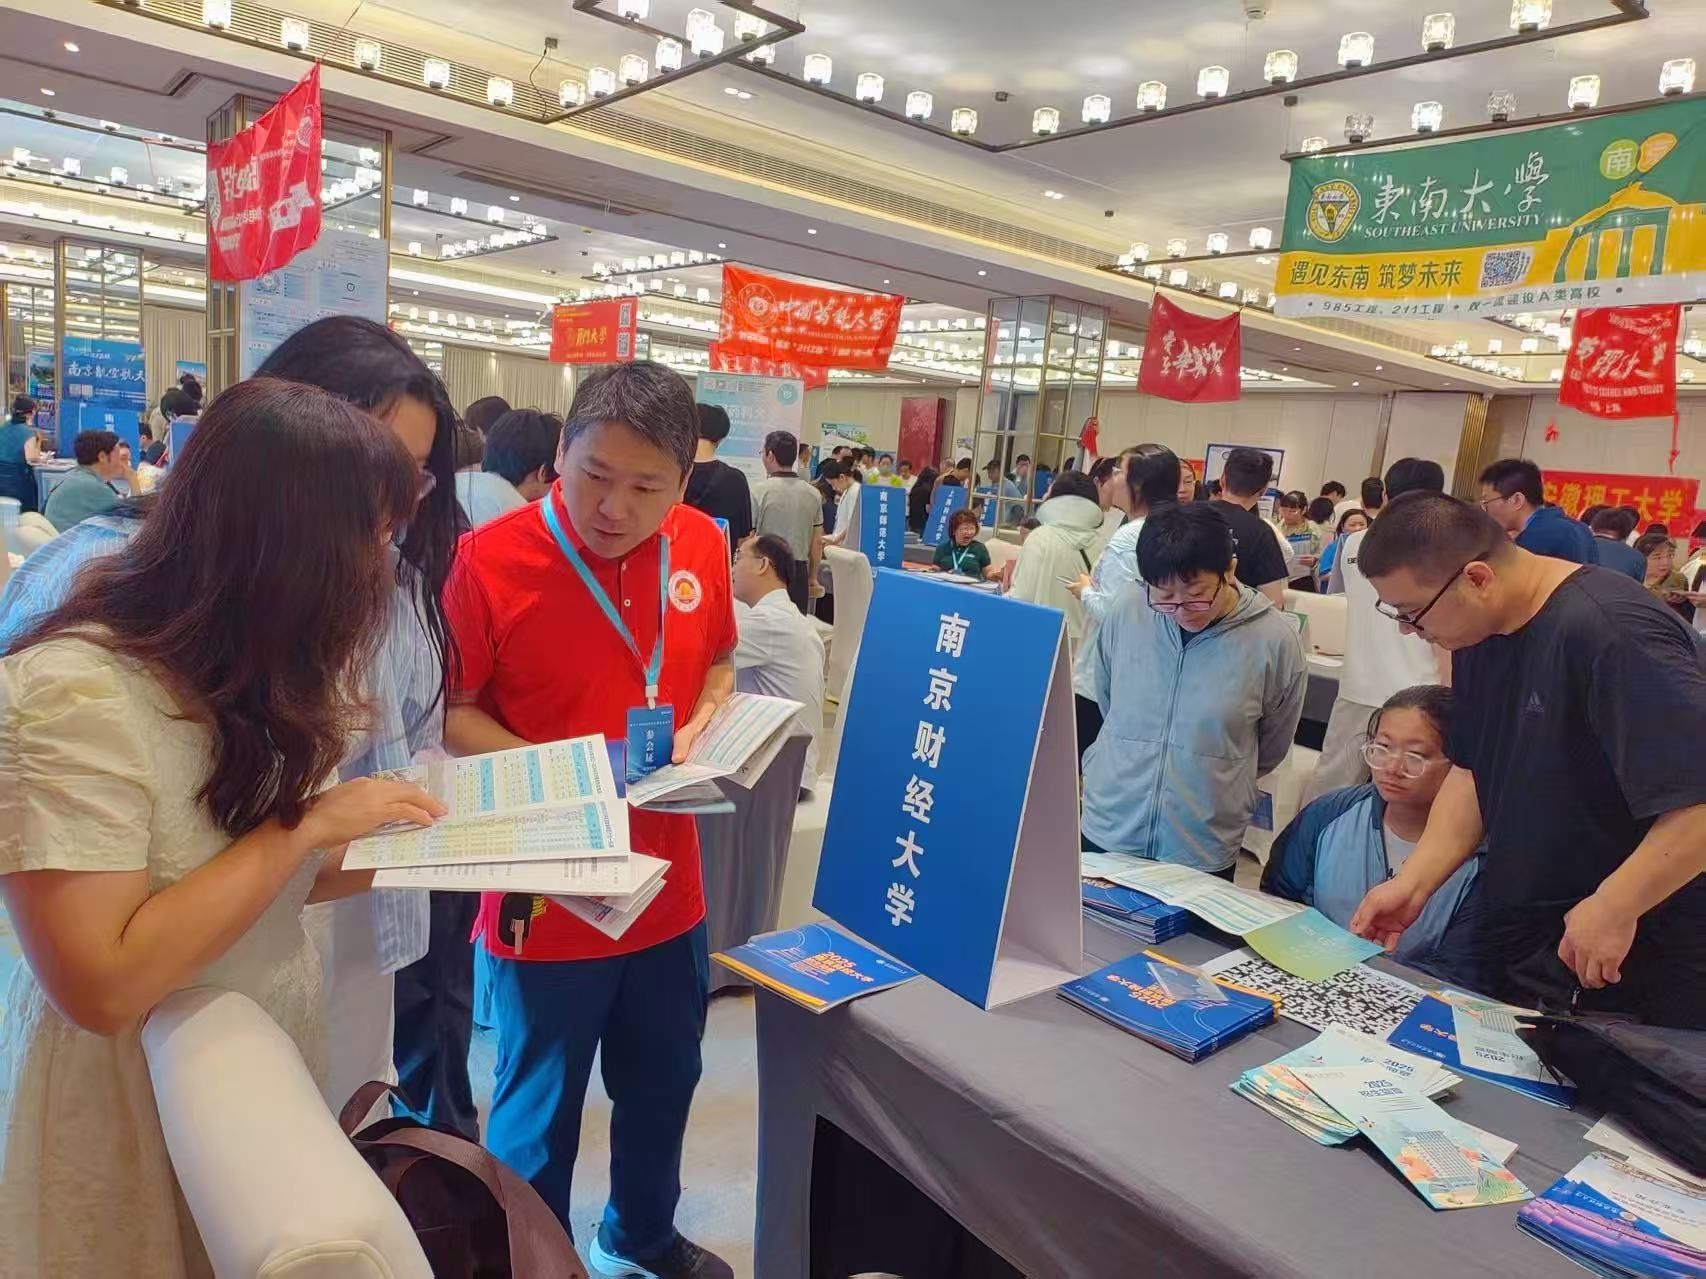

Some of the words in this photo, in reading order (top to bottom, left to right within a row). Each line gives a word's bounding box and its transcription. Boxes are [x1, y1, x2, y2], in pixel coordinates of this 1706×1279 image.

[1364, 223, 1449, 238] SOUTHEAST
[1450, 212, 1544, 234] UNIVERSITY
[1289, 260, 1370, 289] 遇见东南
[1378, 260, 1463, 289] 筑梦未来
[884, 612, 971, 927] 南京财经大学
